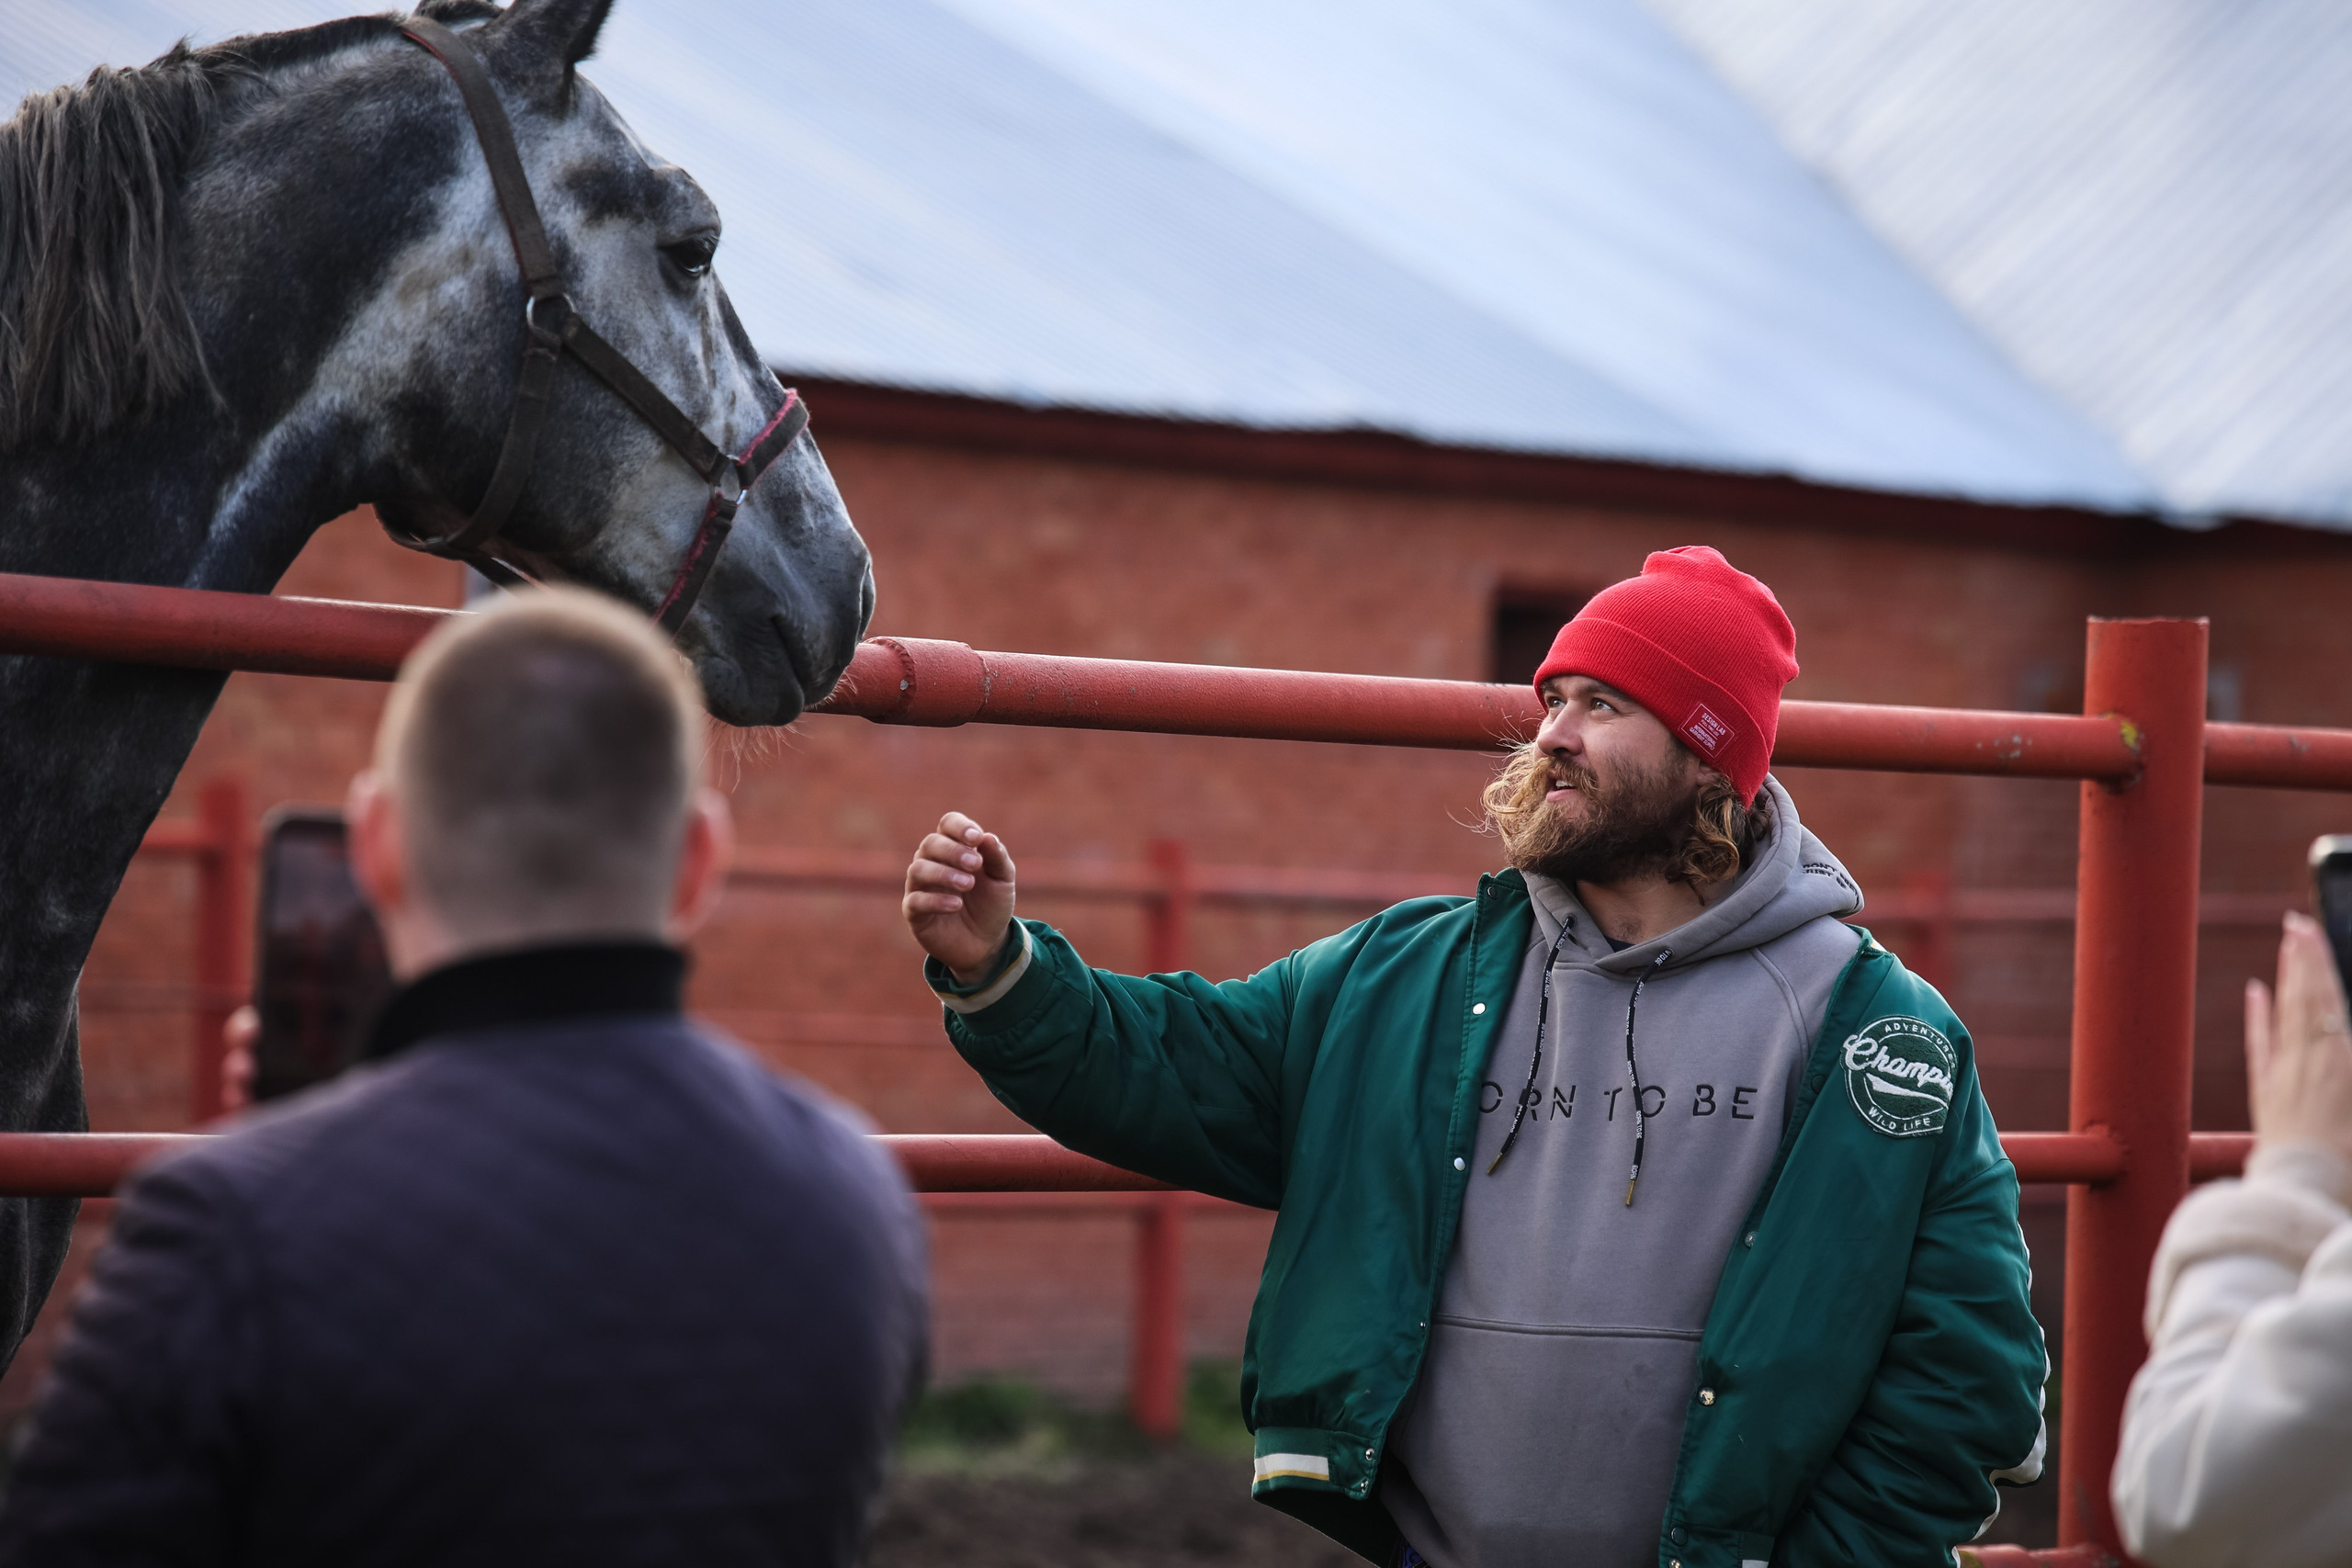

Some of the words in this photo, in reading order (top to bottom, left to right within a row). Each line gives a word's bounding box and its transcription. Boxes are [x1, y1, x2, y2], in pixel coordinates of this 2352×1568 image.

[1479, 1081, 1577, 1122] ORN
[1604, 1085, 1667, 1121] TO
[1692, 1084, 1758, 1120] BE
[1868, 1106, 1897, 1130] WILD
[1903, 1117, 1931, 1131] LIFE
